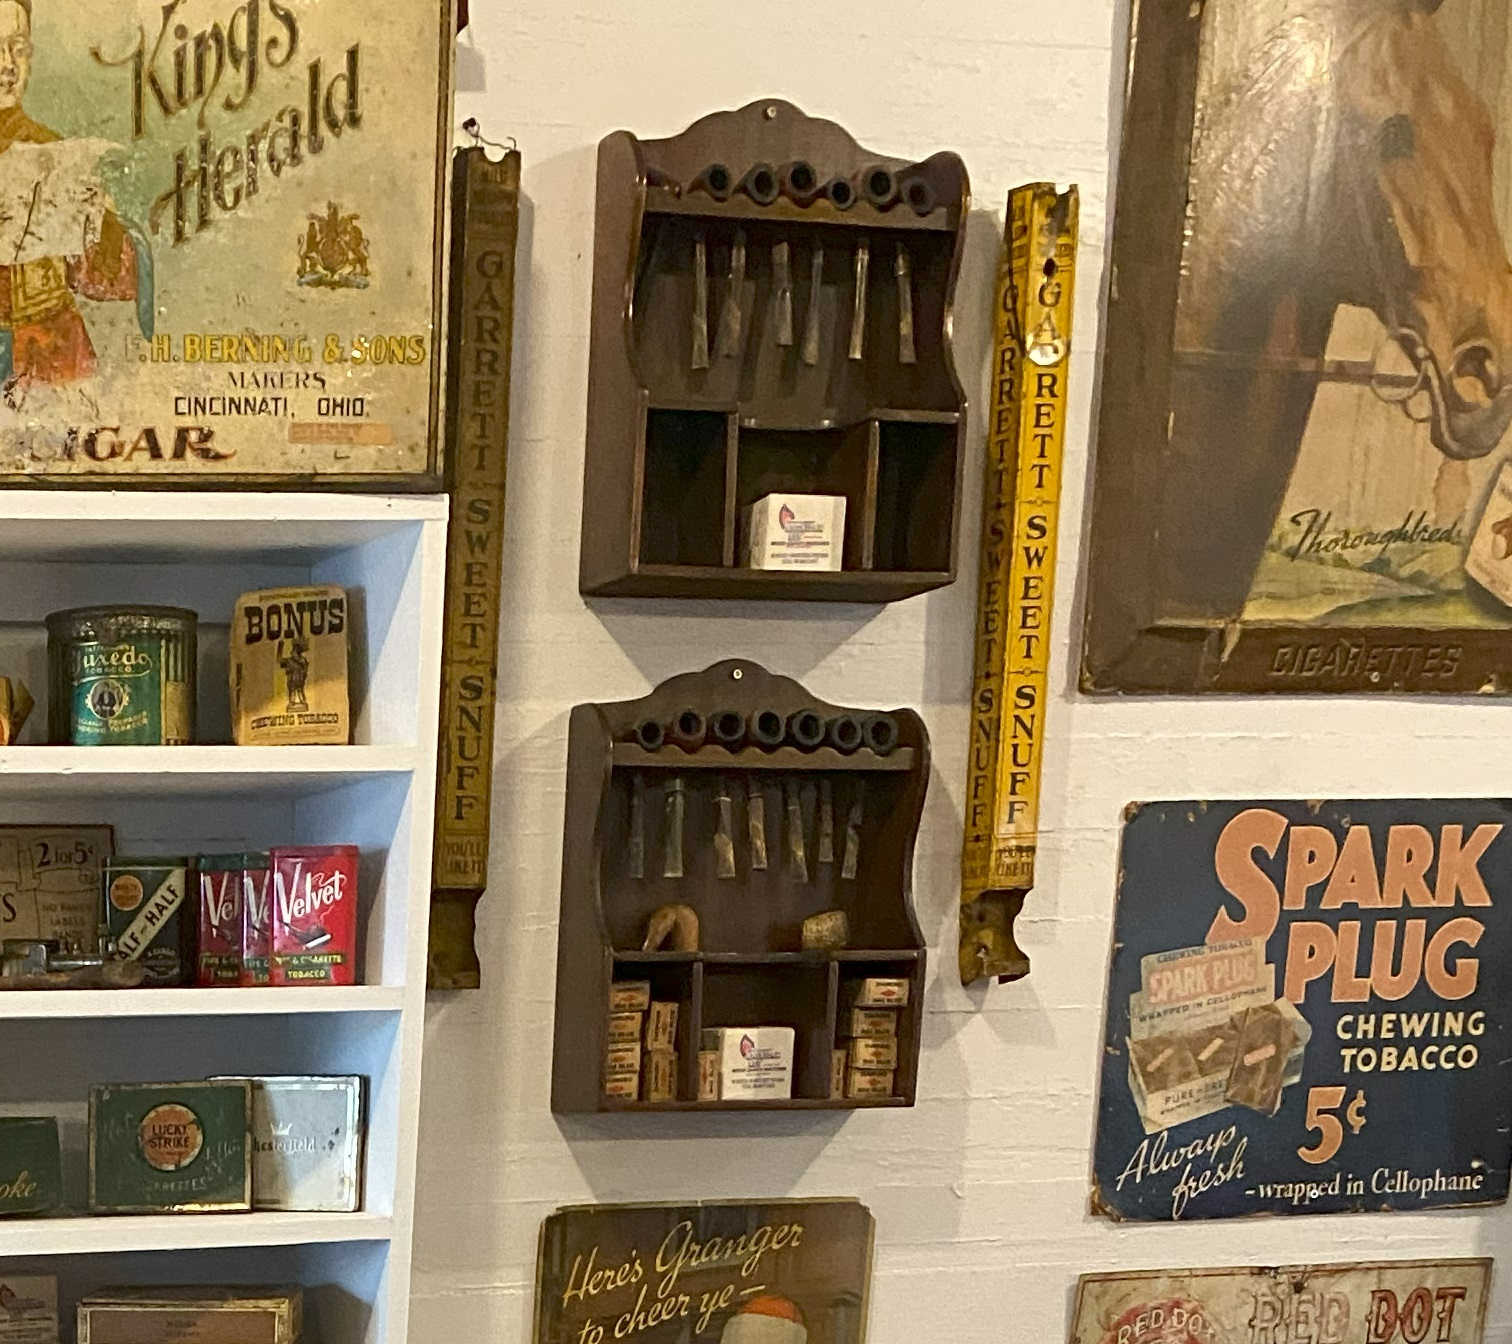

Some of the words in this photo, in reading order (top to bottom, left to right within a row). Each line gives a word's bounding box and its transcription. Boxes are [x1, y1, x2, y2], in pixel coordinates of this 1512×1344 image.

[149, 41, 365, 247] Herald
[182, 333, 313, 363] BERNING
[321, 333, 350, 363] &
[351, 335, 427, 364] SONS
[472, 249, 503, 473] GARRETT
[228, 371, 326, 389] MAKERS
[461, 497, 491, 651] SWEET
[1020, 515, 1048, 660] SWEET
[244, 598, 344, 645] BONUS
[1270, 643, 1462, 679] CIGARETTES
[454, 674, 484, 821] SNUFF
[1006, 684, 1037, 825] SNUFF
[37, 843, 50, 868] 2
[1206, 808, 1503, 942] SPARK
[144, 883, 180, 927] HALF
[274, 862, 347, 926] Velvet
[1149, 965, 1208, 1003] SPARK
[1212, 955, 1256, 991] PLUG
[1283, 917, 1485, 1004] PLUG
[1337, 1011, 1485, 1040] CHEWING
[1340, 1045, 1478, 1073] TOBACCO
[149, 1136, 190, 1149] STRIKE
[151, 1124, 189, 1137] LUCKY
[1297, 1085, 1367, 1165] 5¢
[1172, 1136, 1248, 1219] fresh
[1345, 1173, 1364, 1195] in
[1371, 1167, 1484, 1199] Cellophane
[563, 1246, 643, 1309] Here's
[655, 1221, 805, 1299] Granger
[614, 1284, 690, 1338] cheer
